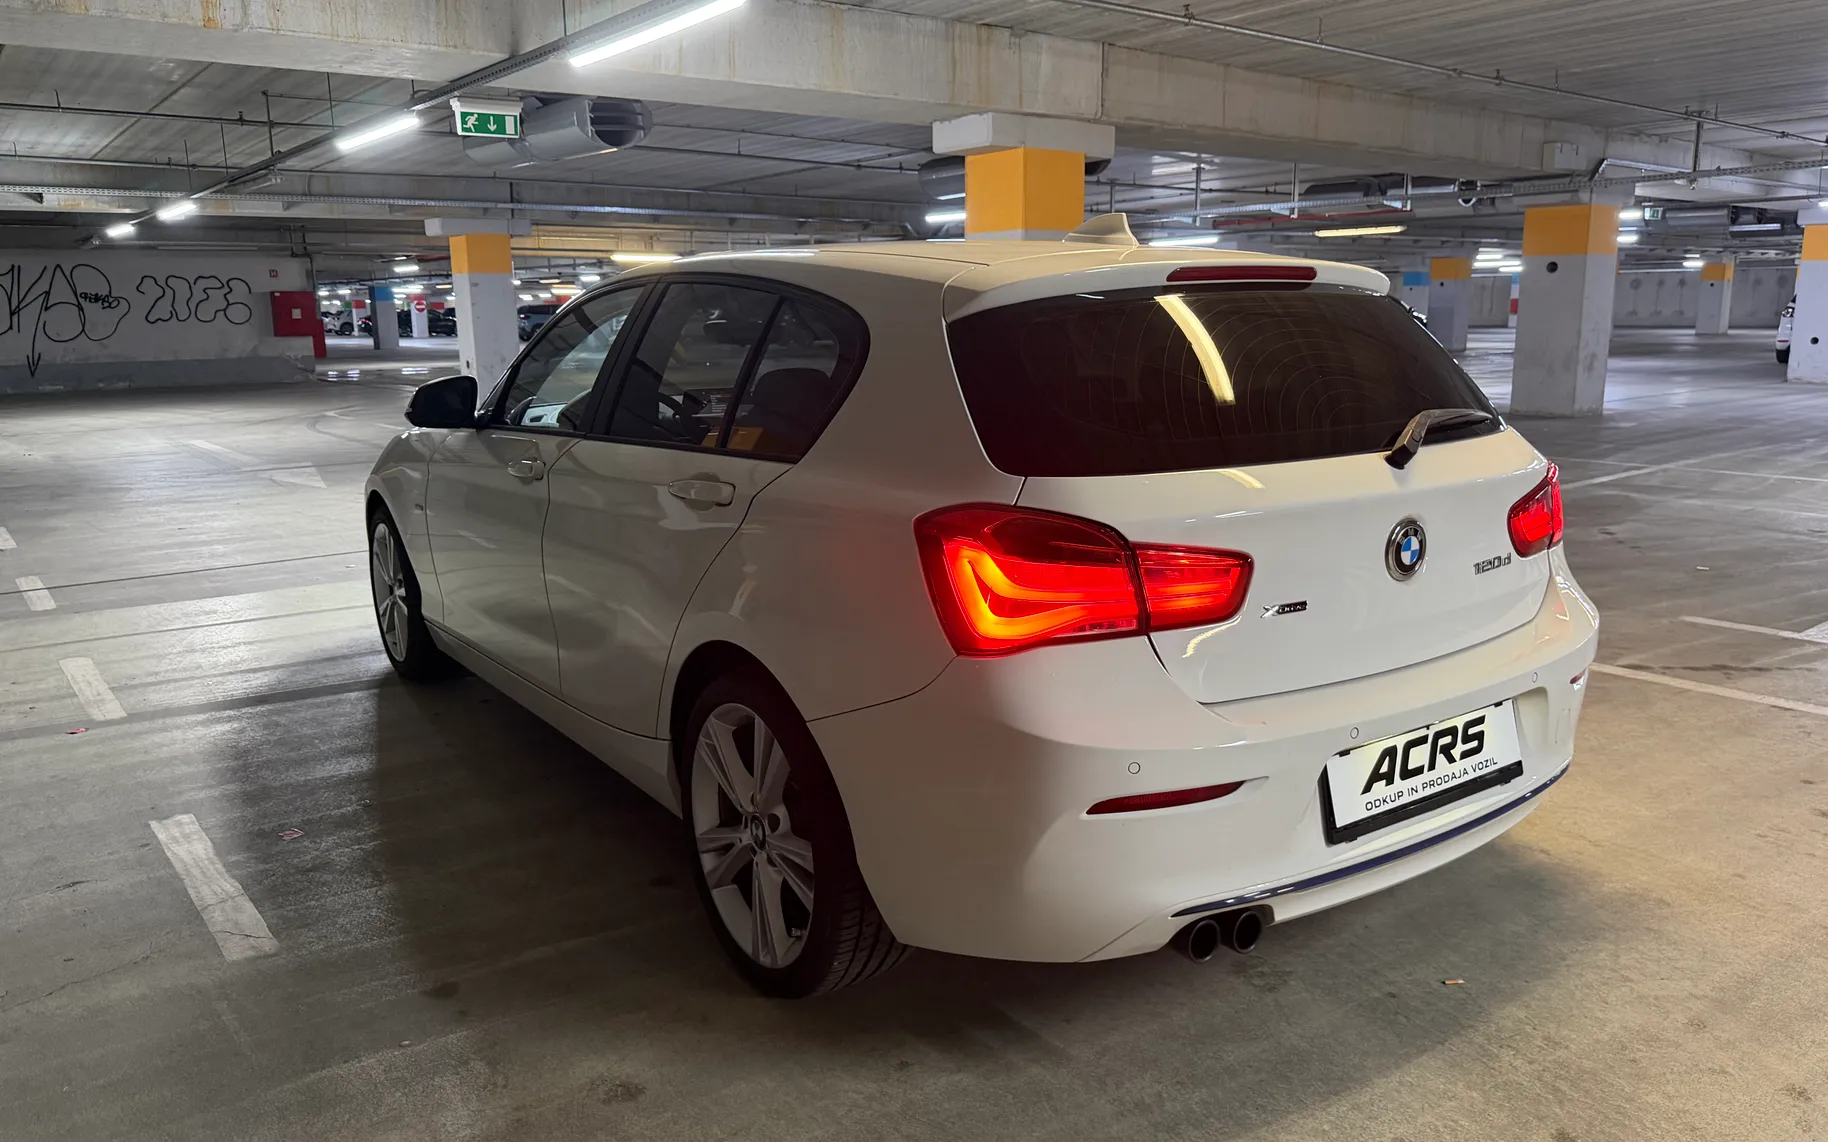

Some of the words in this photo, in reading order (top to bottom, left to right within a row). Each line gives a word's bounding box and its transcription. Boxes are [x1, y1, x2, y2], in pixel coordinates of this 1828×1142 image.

[1473, 552, 1512, 575] 120d
[1360, 714, 1486, 795] ACRS
[1365, 791, 1404, 811] ODKUP
[1407, 785, 1419, 797] IN
[1422, 769, 1469, 792] PRODAJA
[1471, 756, 1498, 773] VOZIL
